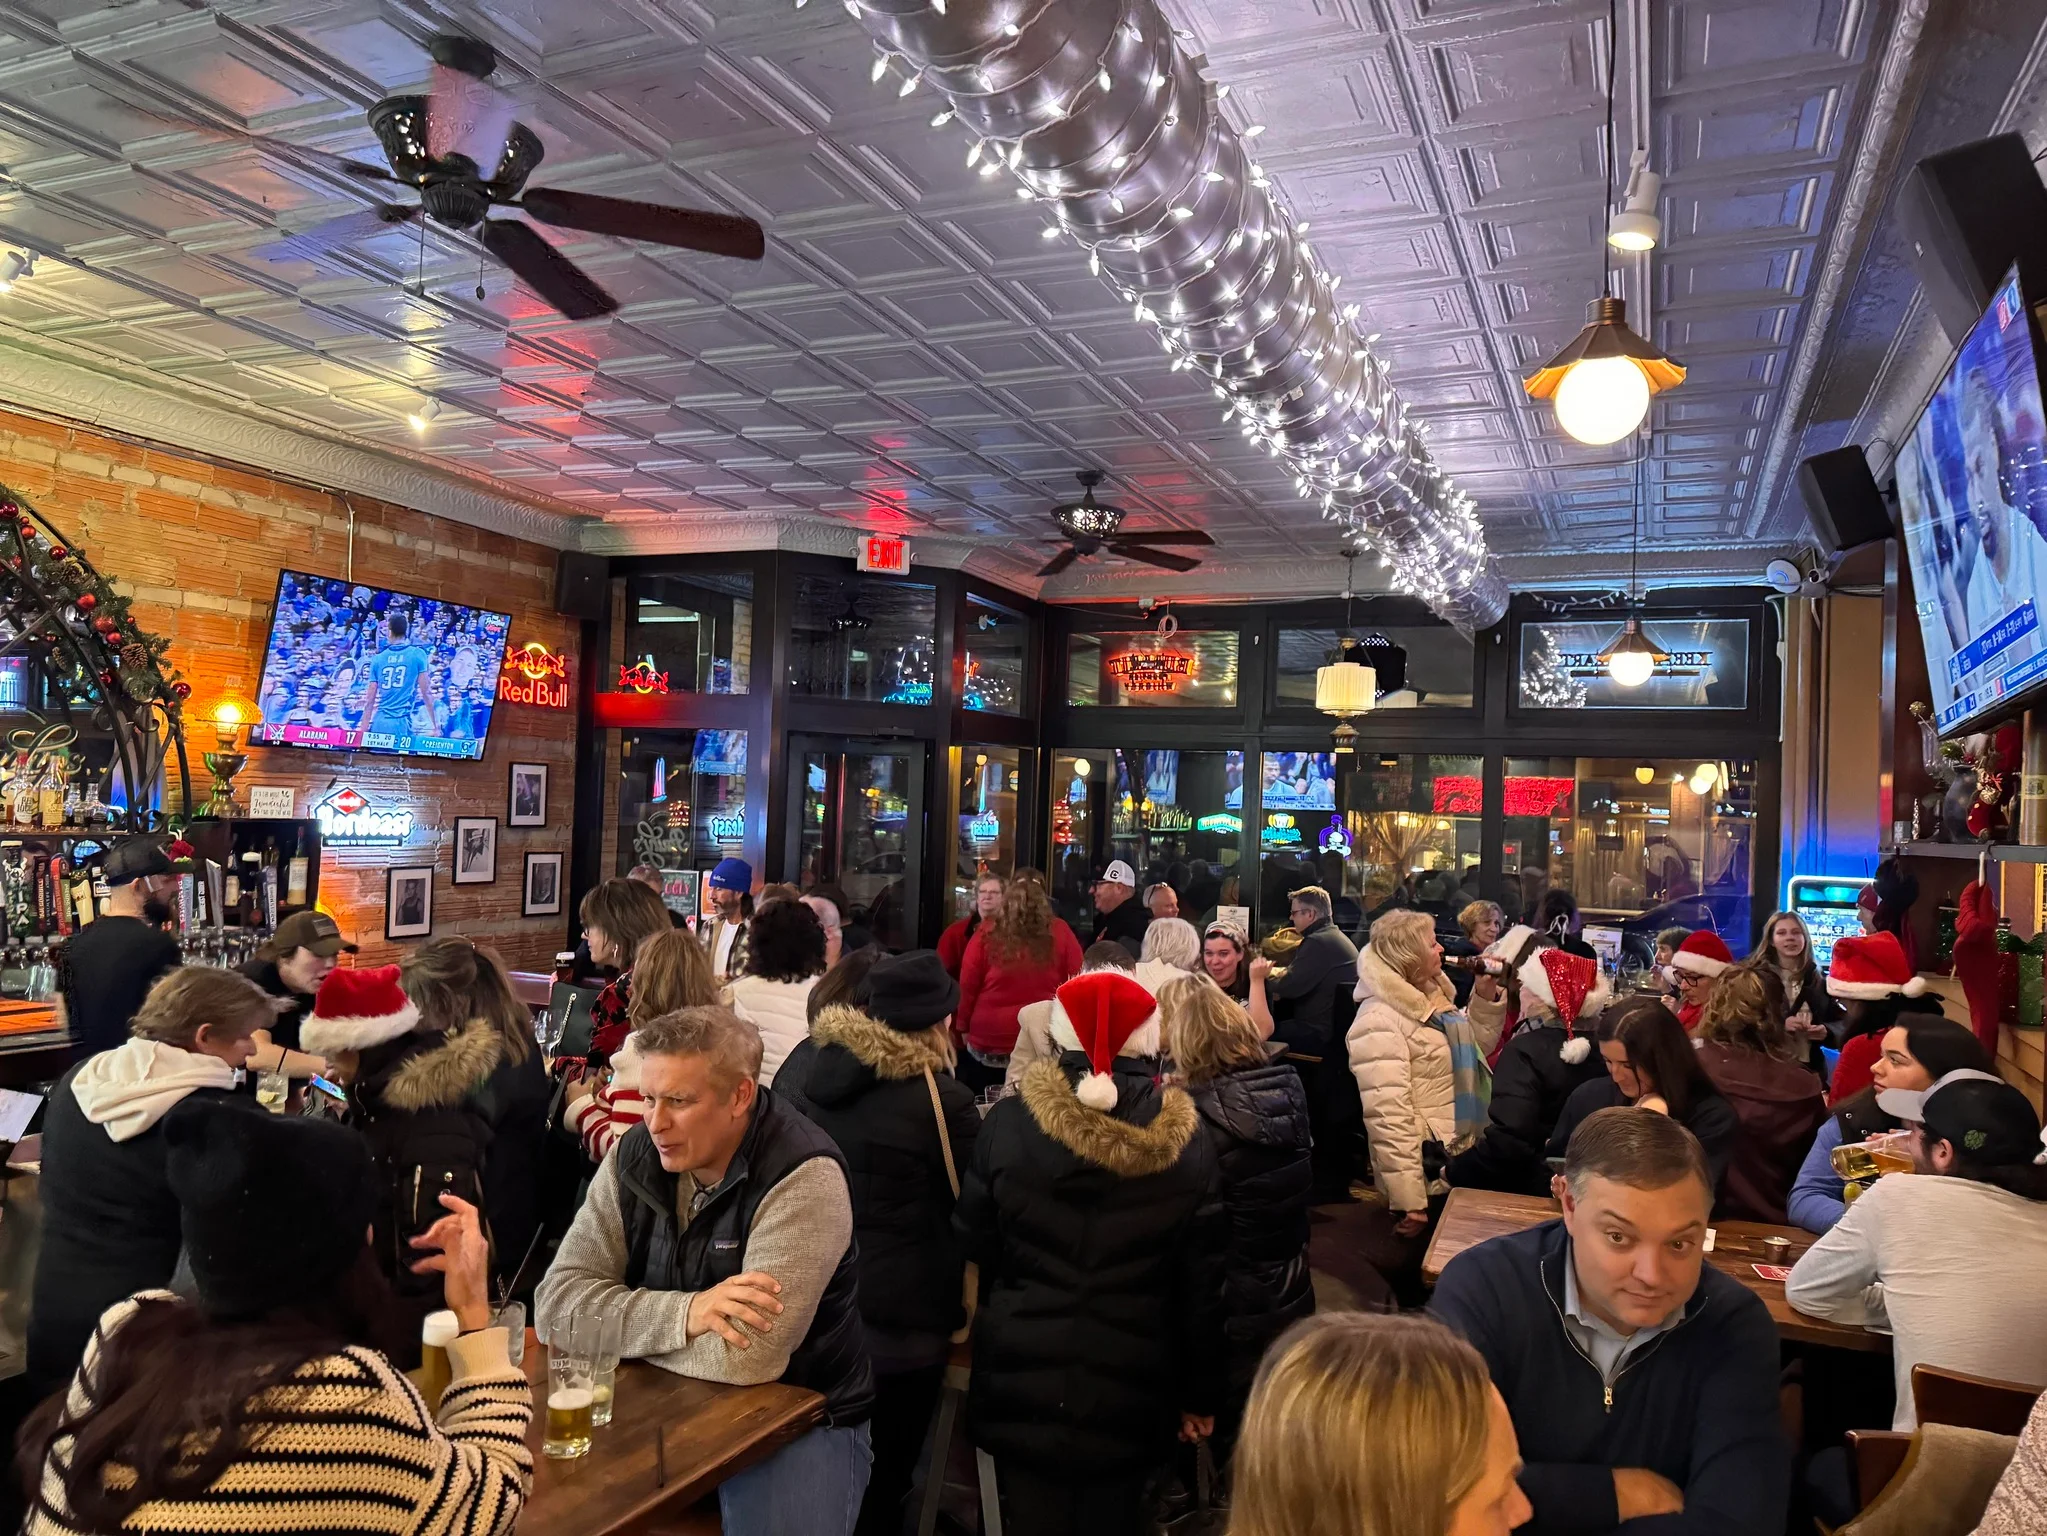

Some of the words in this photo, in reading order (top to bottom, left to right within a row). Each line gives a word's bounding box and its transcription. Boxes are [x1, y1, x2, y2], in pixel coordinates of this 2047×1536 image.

[868, 538, 904, 569] EXIT
[382, 666, 406, 689] 33
[499, 677, 533, 702] Red
[537, 682, 568, 708] Bull
[298, 729, 328, 741] ALABAMA
[345, 731, 357, 744] 17
[400, 736, 411, 749] 20
[665, 882, 689, 895] UGLY
